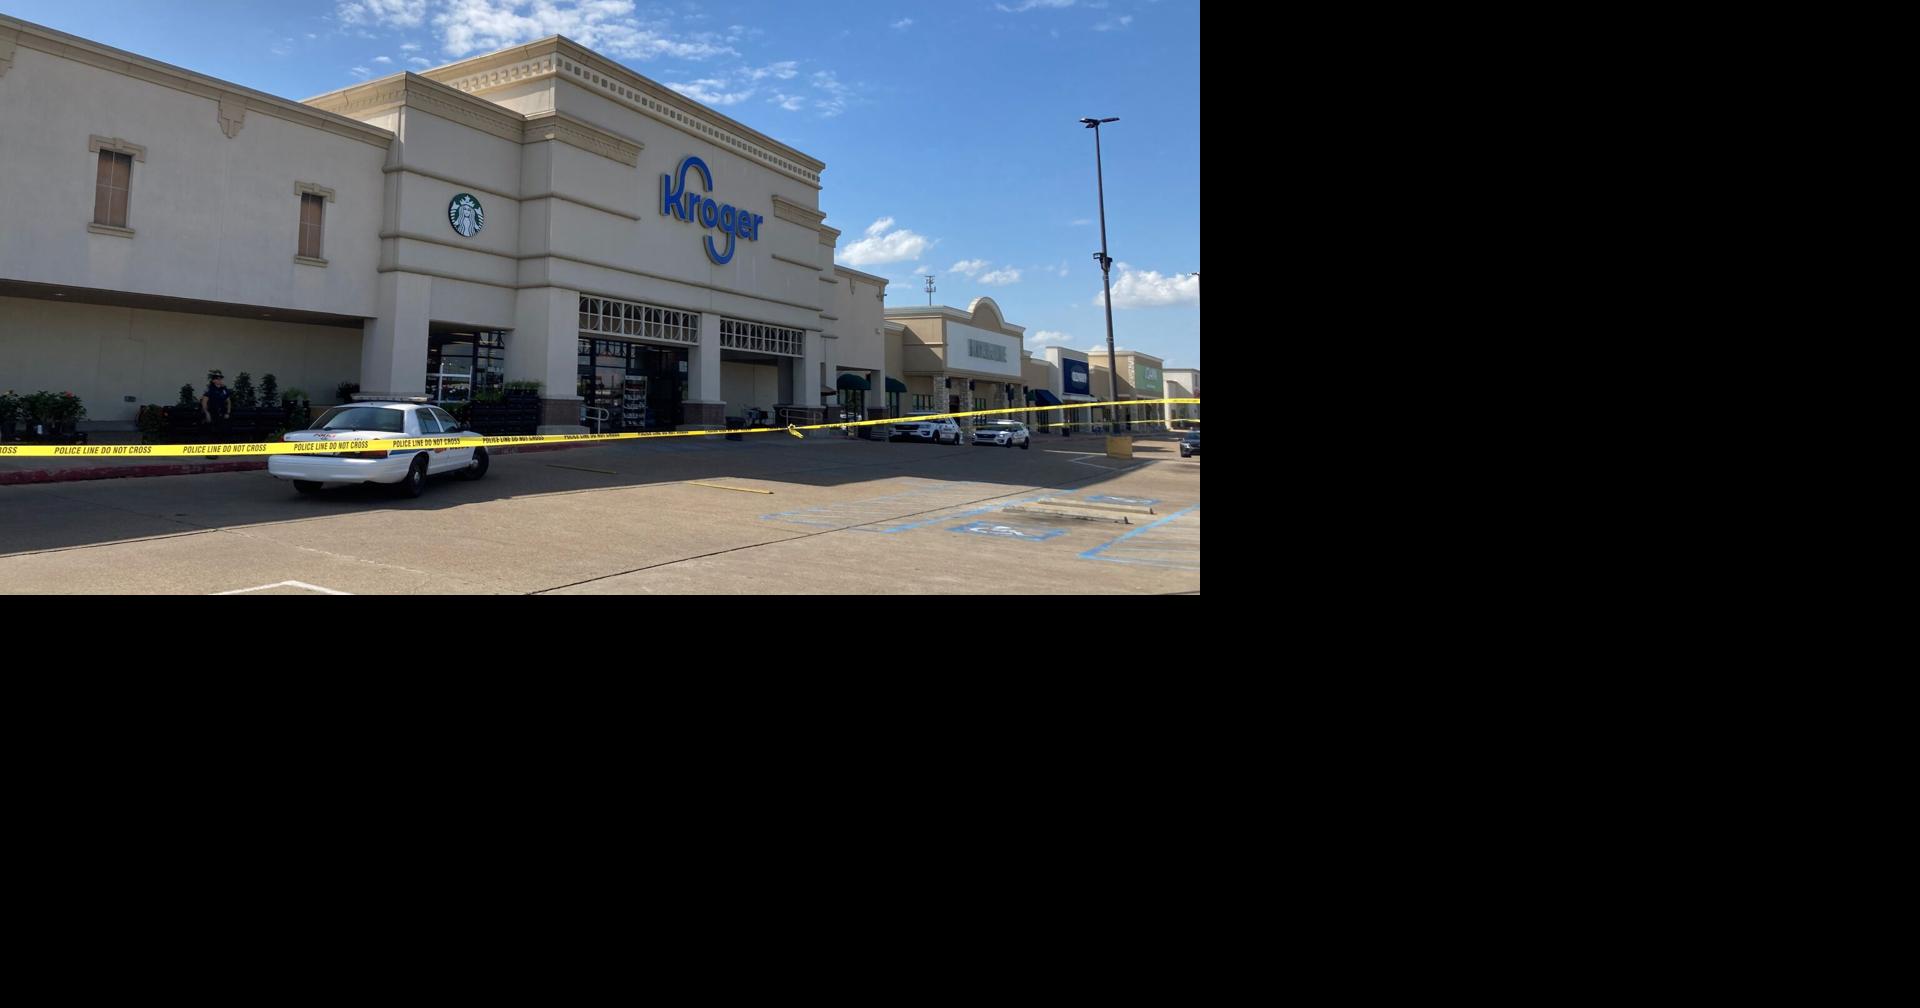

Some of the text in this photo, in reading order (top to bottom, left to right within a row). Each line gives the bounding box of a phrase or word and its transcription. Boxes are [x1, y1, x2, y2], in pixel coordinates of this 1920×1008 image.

[660, 155, 764, 265] Kroger
[293, 441, 369, 451] POLICE LINE DO NOT CROSS
[392, 440, 411, 448] POLICE
[412, 439, 424, 447] LINE
[433, 438, 444, 446] NOT
[444, 437, 461, 445] CROSS
[54, 446, 152, 455] POLICE LINE DO NOT CROSS
[182, 445, 206, 454] POLICE
[207, 445, 222, 453] LINE
[233, 444, 246, 452] NOT
[246, 444, 267, 452] CROSS
